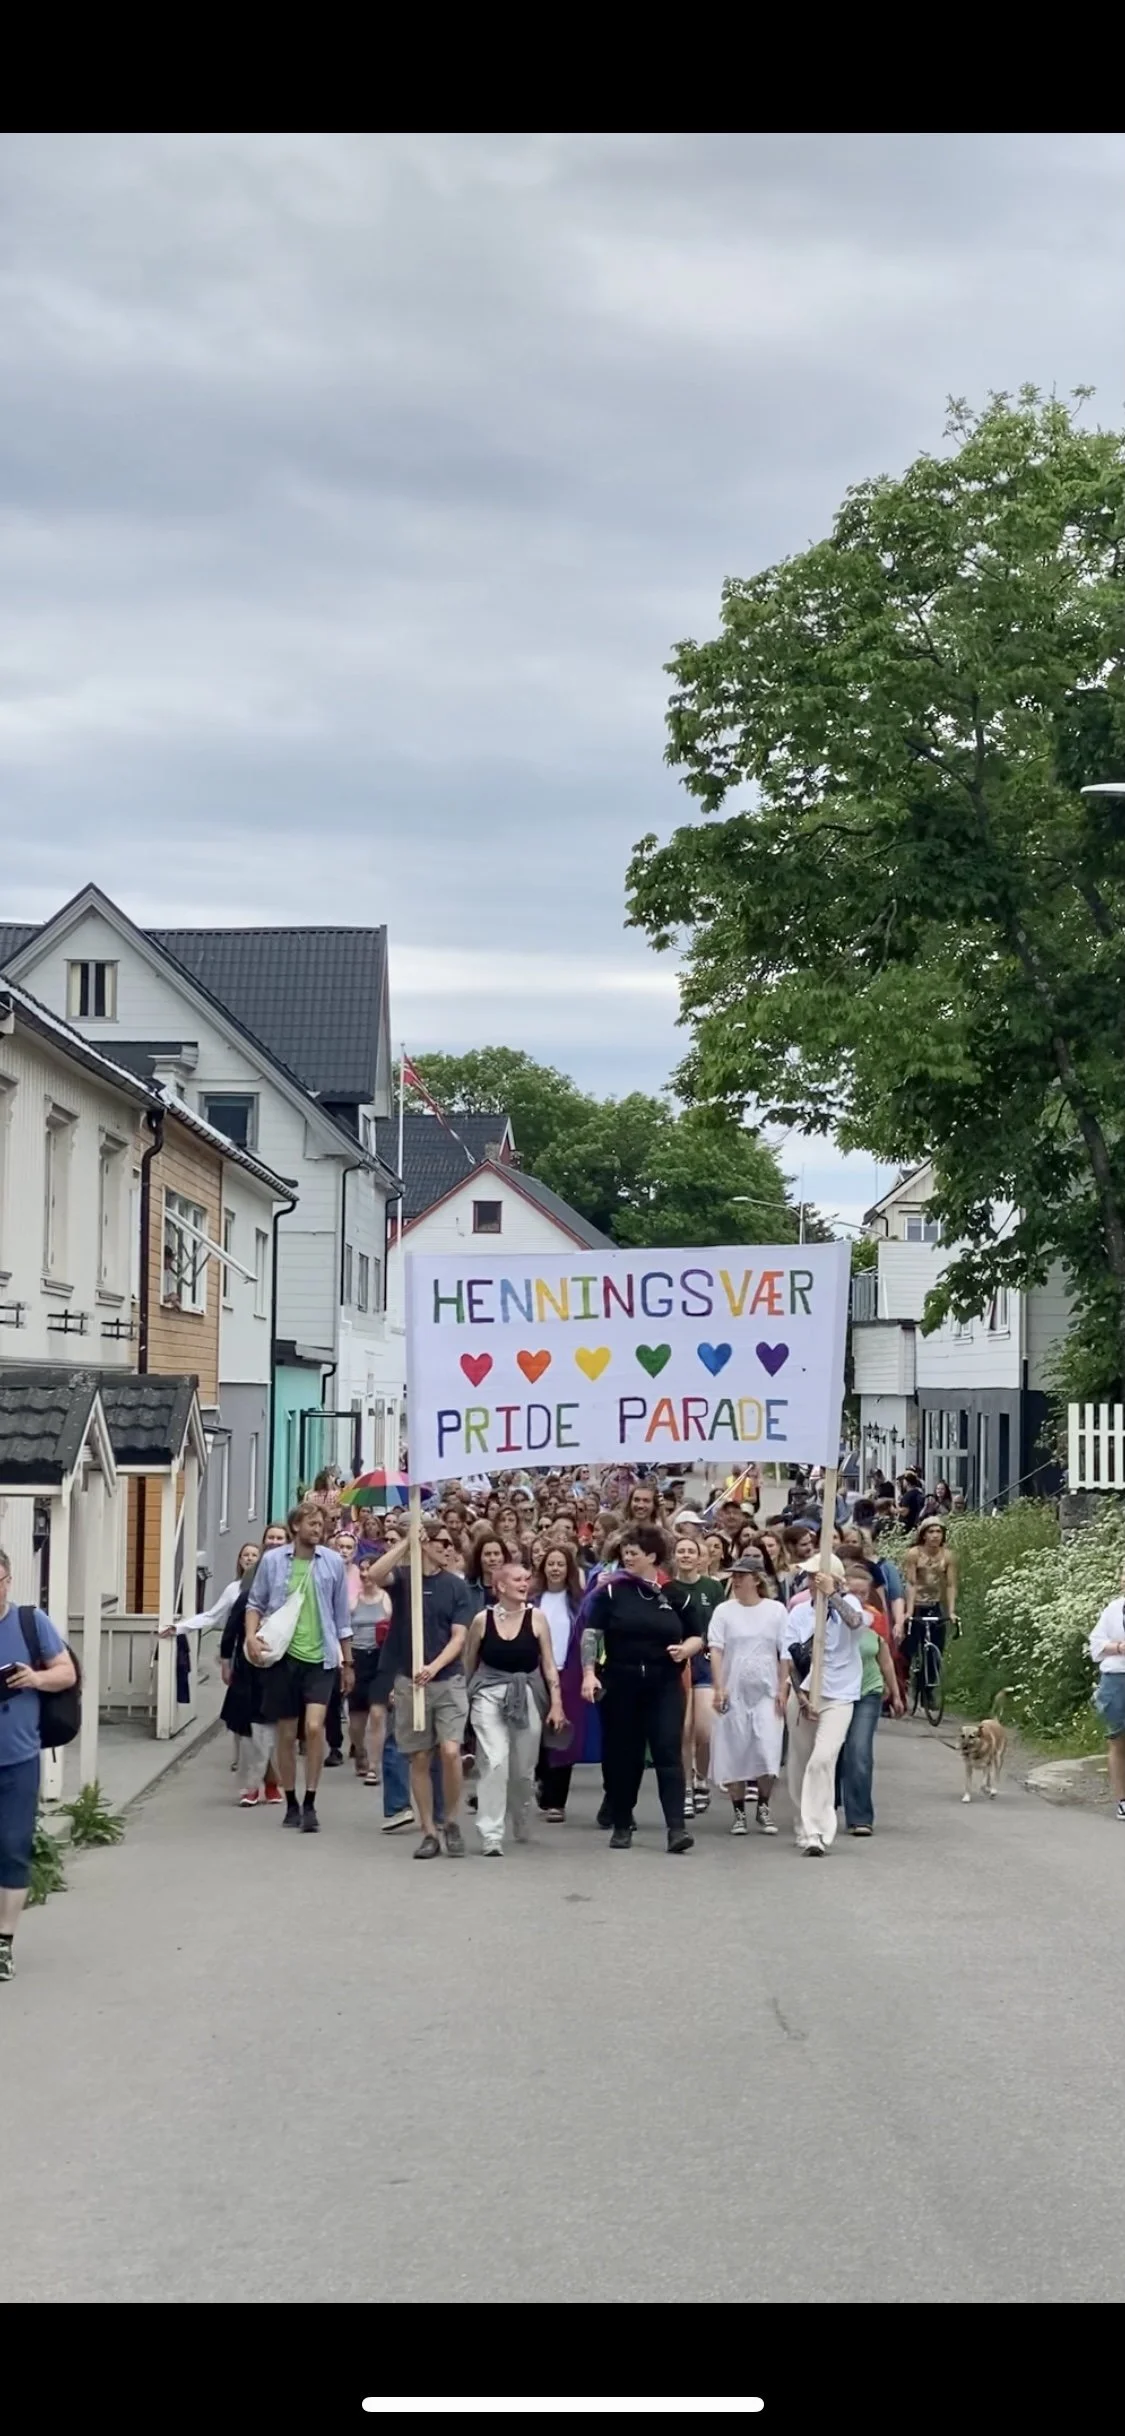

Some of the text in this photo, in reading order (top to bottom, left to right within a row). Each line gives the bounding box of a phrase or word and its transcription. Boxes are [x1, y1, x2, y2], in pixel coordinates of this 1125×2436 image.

[433, 1269, 814, 1324] HENNINGSVÆR
[437, 1397, 788, 1458] PRIDE PARADE
